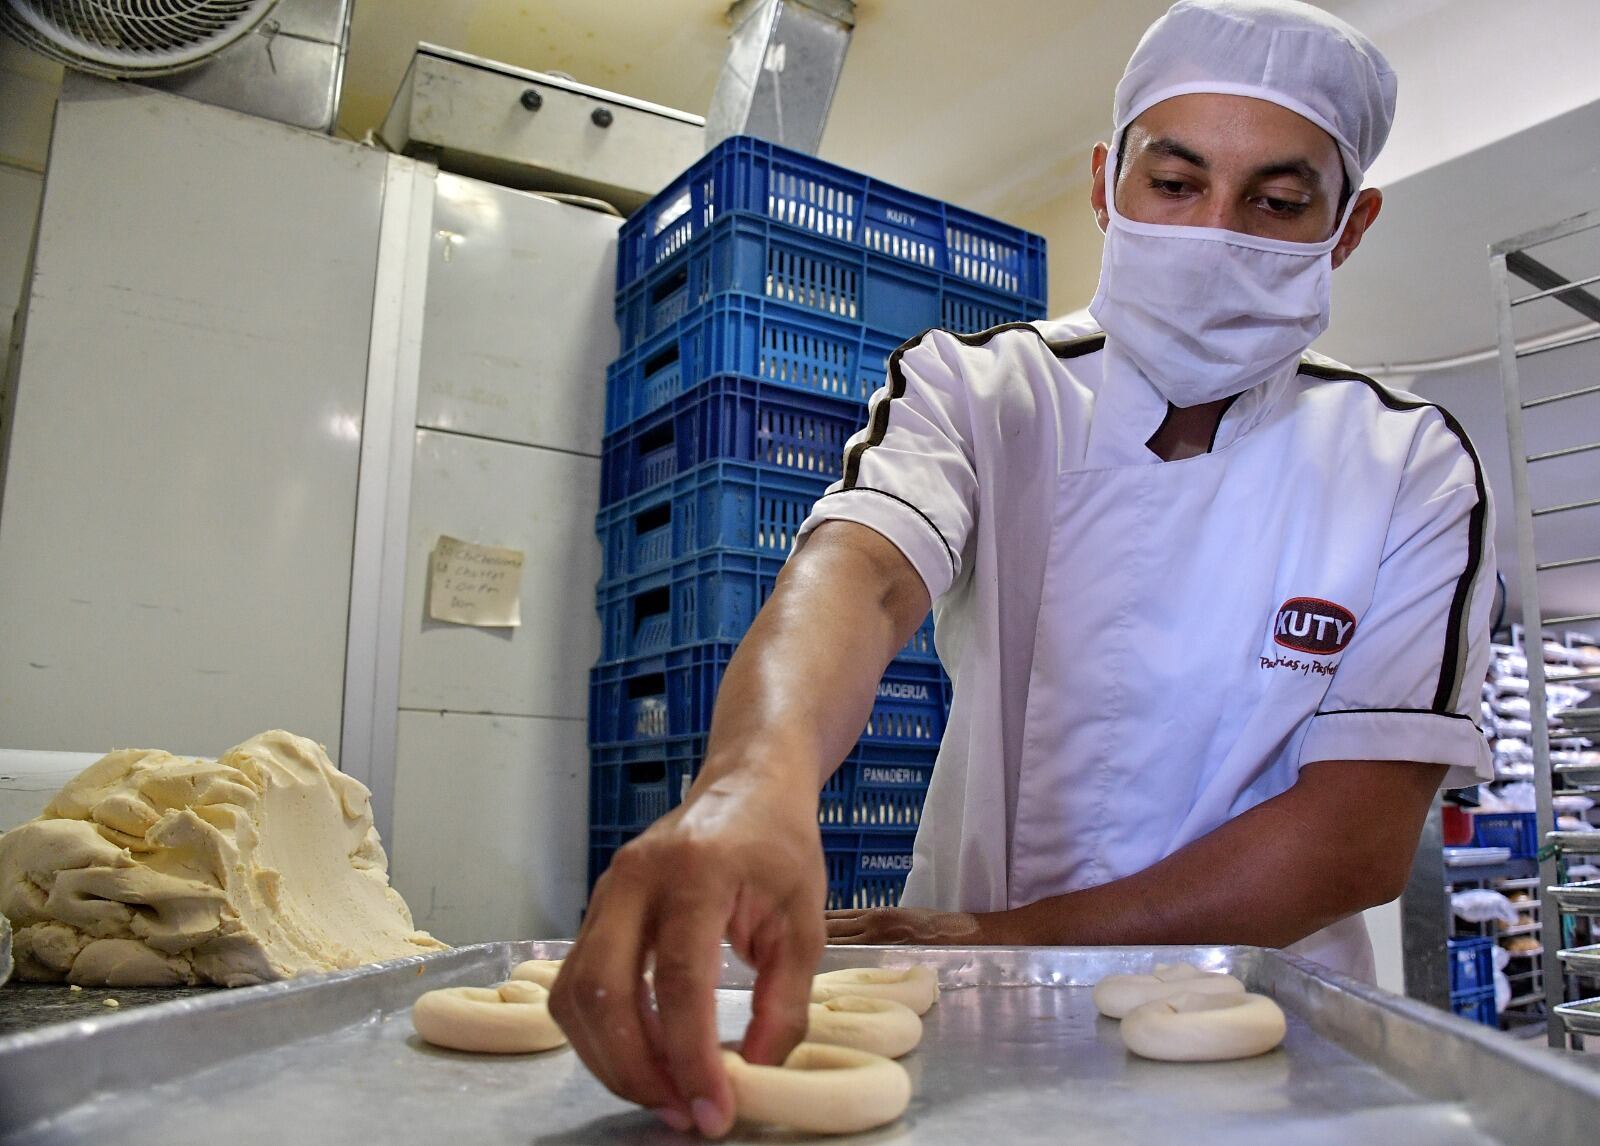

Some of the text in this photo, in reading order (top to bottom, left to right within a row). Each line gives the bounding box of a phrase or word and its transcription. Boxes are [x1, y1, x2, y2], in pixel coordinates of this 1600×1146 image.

[886, 208, 917, 228] KUTY
[1275, 610, 1353, 645] KUTY
[1301, 663, 1310, 676] y
[876, 682, 929, 700] NADERIA
[863, 767, 923, 784] PANADERIA
